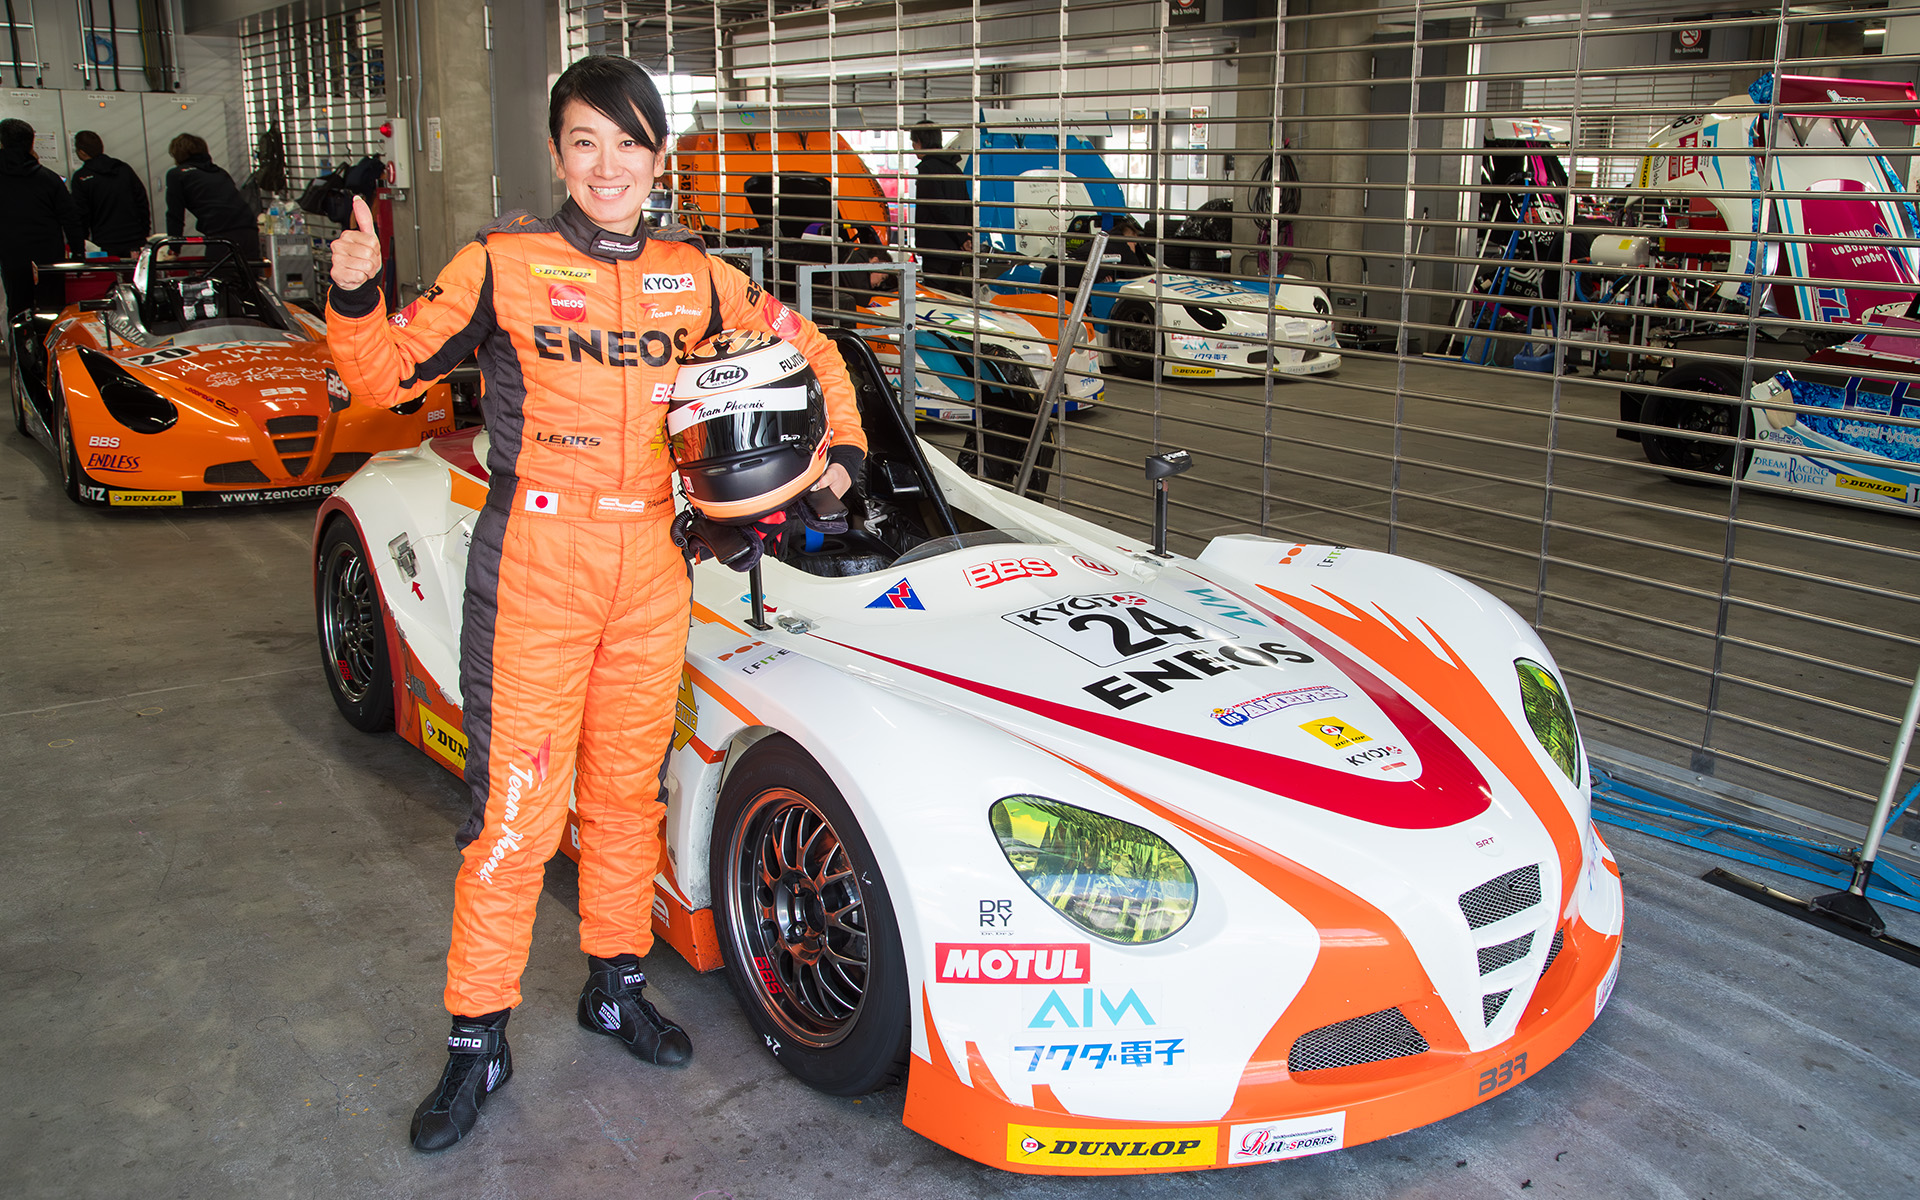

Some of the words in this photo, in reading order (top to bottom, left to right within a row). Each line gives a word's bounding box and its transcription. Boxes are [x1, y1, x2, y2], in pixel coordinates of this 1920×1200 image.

[1683, 136, 1696, 174] MTUL
[544, 267, 592, 279] DUNLOP
[551, 298, 584, 309] ENEOS
[650, 308, 673, 319] Team
[674, 305, 704, 318] Phoenix
[533, 325, 692, 368] ENEOS
[127, 348, 194, 367] 20
[701, 368, 743, 384] Arai
[427, 408, 447, 422] BBS
[698, 407, 721, 419] Team
[723, 400, 765, 413] Phoenix
[89, 436, 121, 449] BBS
[536, 432, 603, 447] LEARS
[87, 453, 141, 470] ENDLESS
[1754, 456, 1788, 470] DREAM
[1790, 457, 1830, 482] RACING
[1784, 470, 1827, 486] PROJECT
[1848, 480, 1902, 494] DUNLOP
[122, 494, 177, 502] DUNLOP
[219, 484, 339, 503] www.zencoffee
[963, 558, 1059, 589] BBS
[1068, 606, 1208, 657] 24
[336, 659, 353, 682] BBS
[1081, 642, 1316, 711] ENEOS
[1241, 687, 1348, 719] AMEFES
[1220, 711, 1244, 725] IAF
[437, 728, 467, 761] DUN
[507, 762, 534, 823] Team
[1475, 836, 1495, 848] SRT
[979, 899, 1013, 912] DR
[979, 913, 1013, 927] RY
[942, 949, 1084, 980] MOTUL
[754, 956, 783, 994] BBS
[1027, 987, 1157, 1029] AIM
[763, 1033, 782, 1057] 24
[1014, 1038, 1185, 1073] フクダ電子
[1049, 1139, 1201, 1157] DUNLOP
